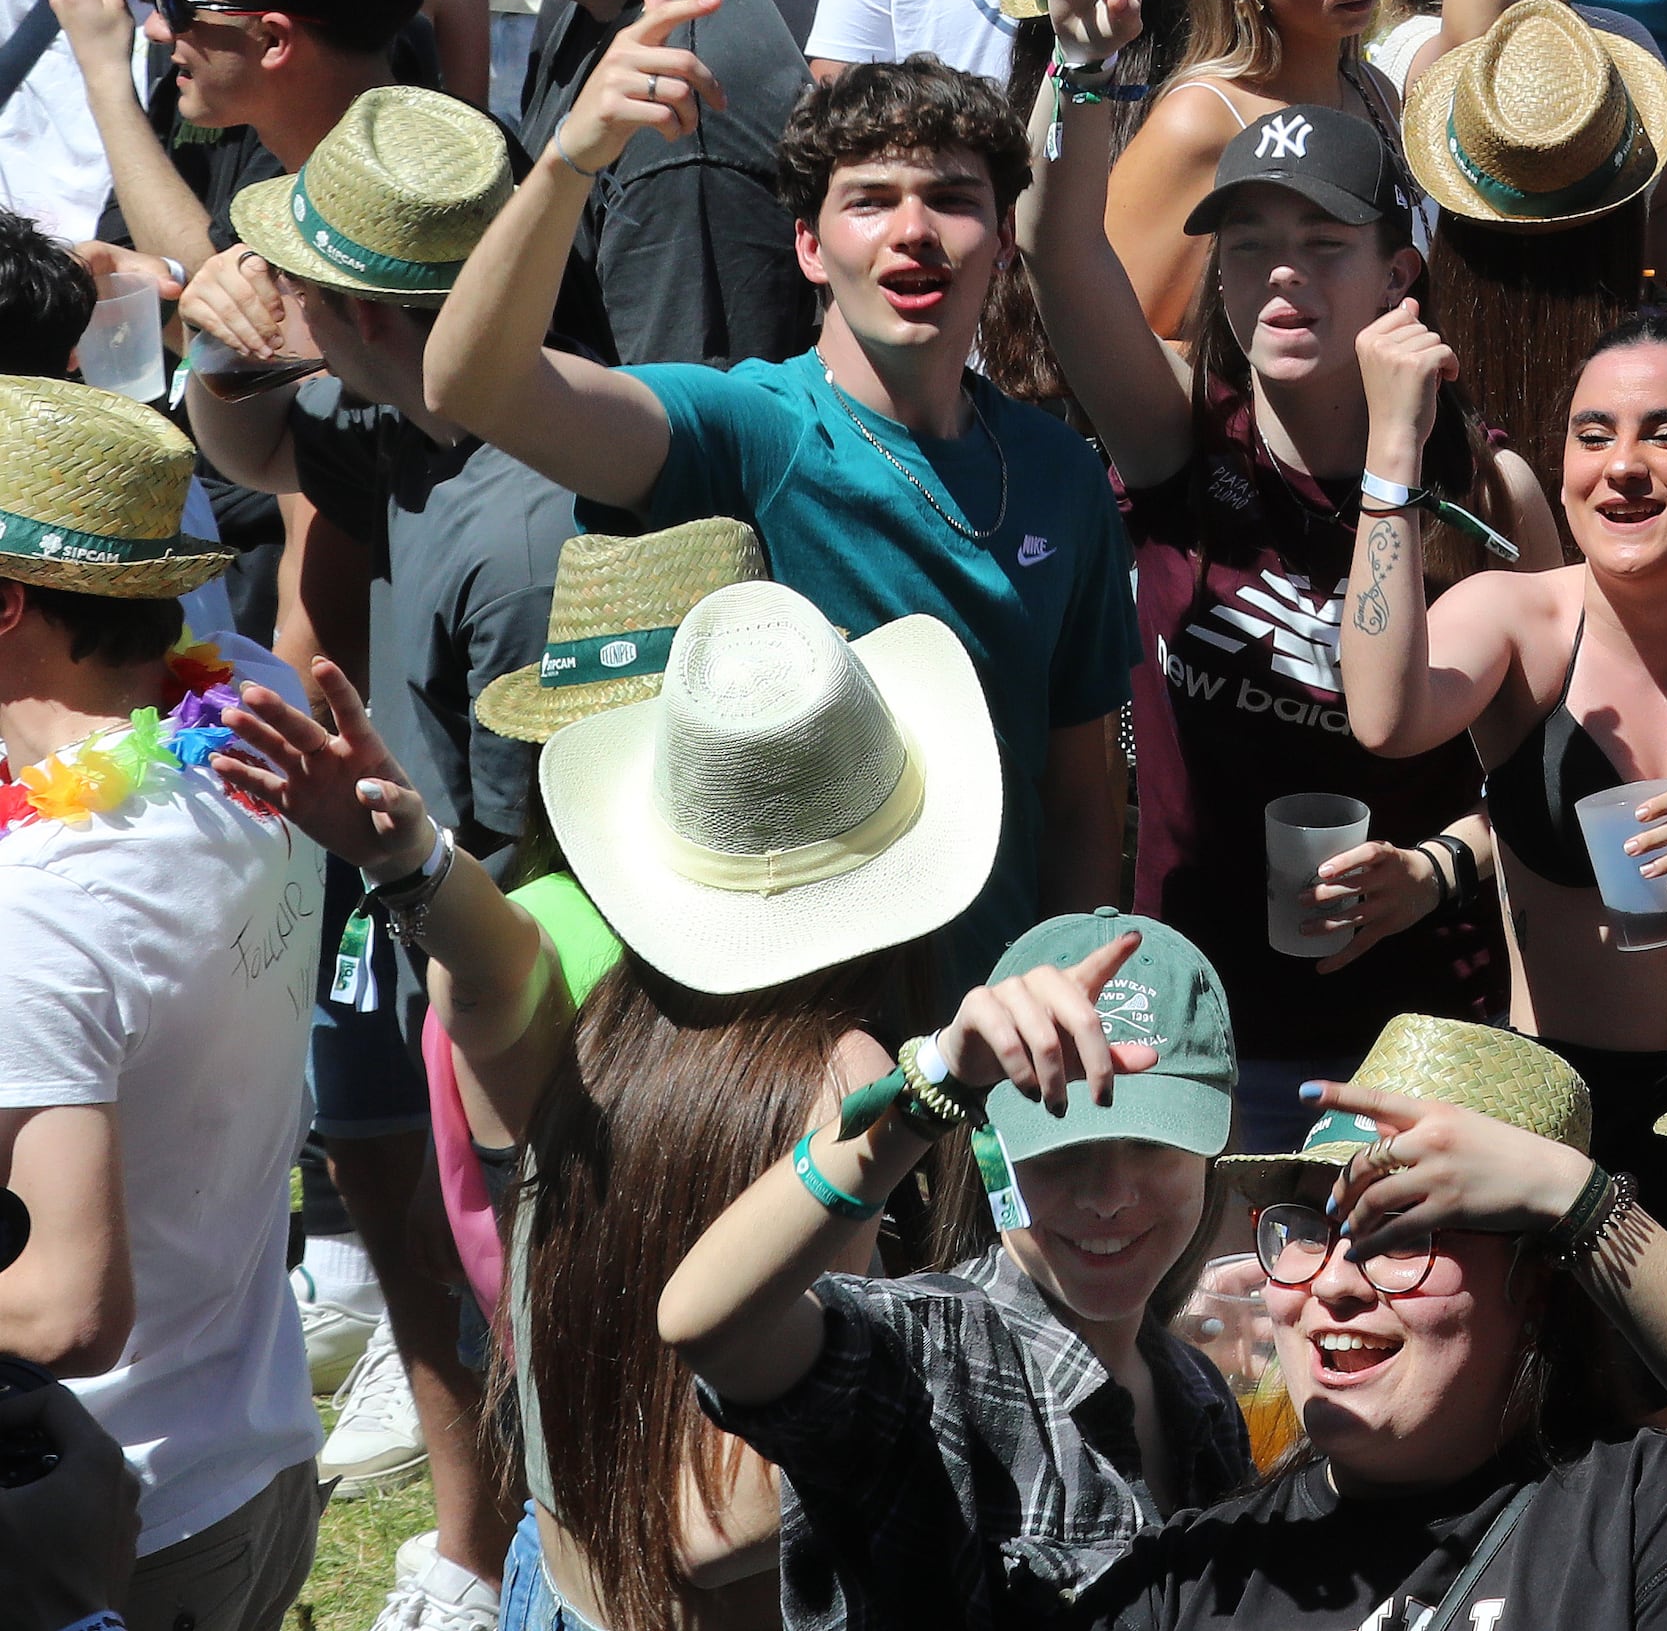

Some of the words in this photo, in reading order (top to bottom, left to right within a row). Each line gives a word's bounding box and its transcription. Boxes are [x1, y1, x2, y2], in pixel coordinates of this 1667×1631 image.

[1254, 114, 1315, 160] NY
[327, 244, 367, 274] SIPCAM
[1212, 465, 1250, 493] PLATA
[1209, 484, 1251, 511] PLOMO
[62, 545, 120, 565] SIPCAM
[1023, 534, 1048, 555] NIKE
[1157, 633, 1228, 700] new
[1237, 678, 1352, 742] bala
